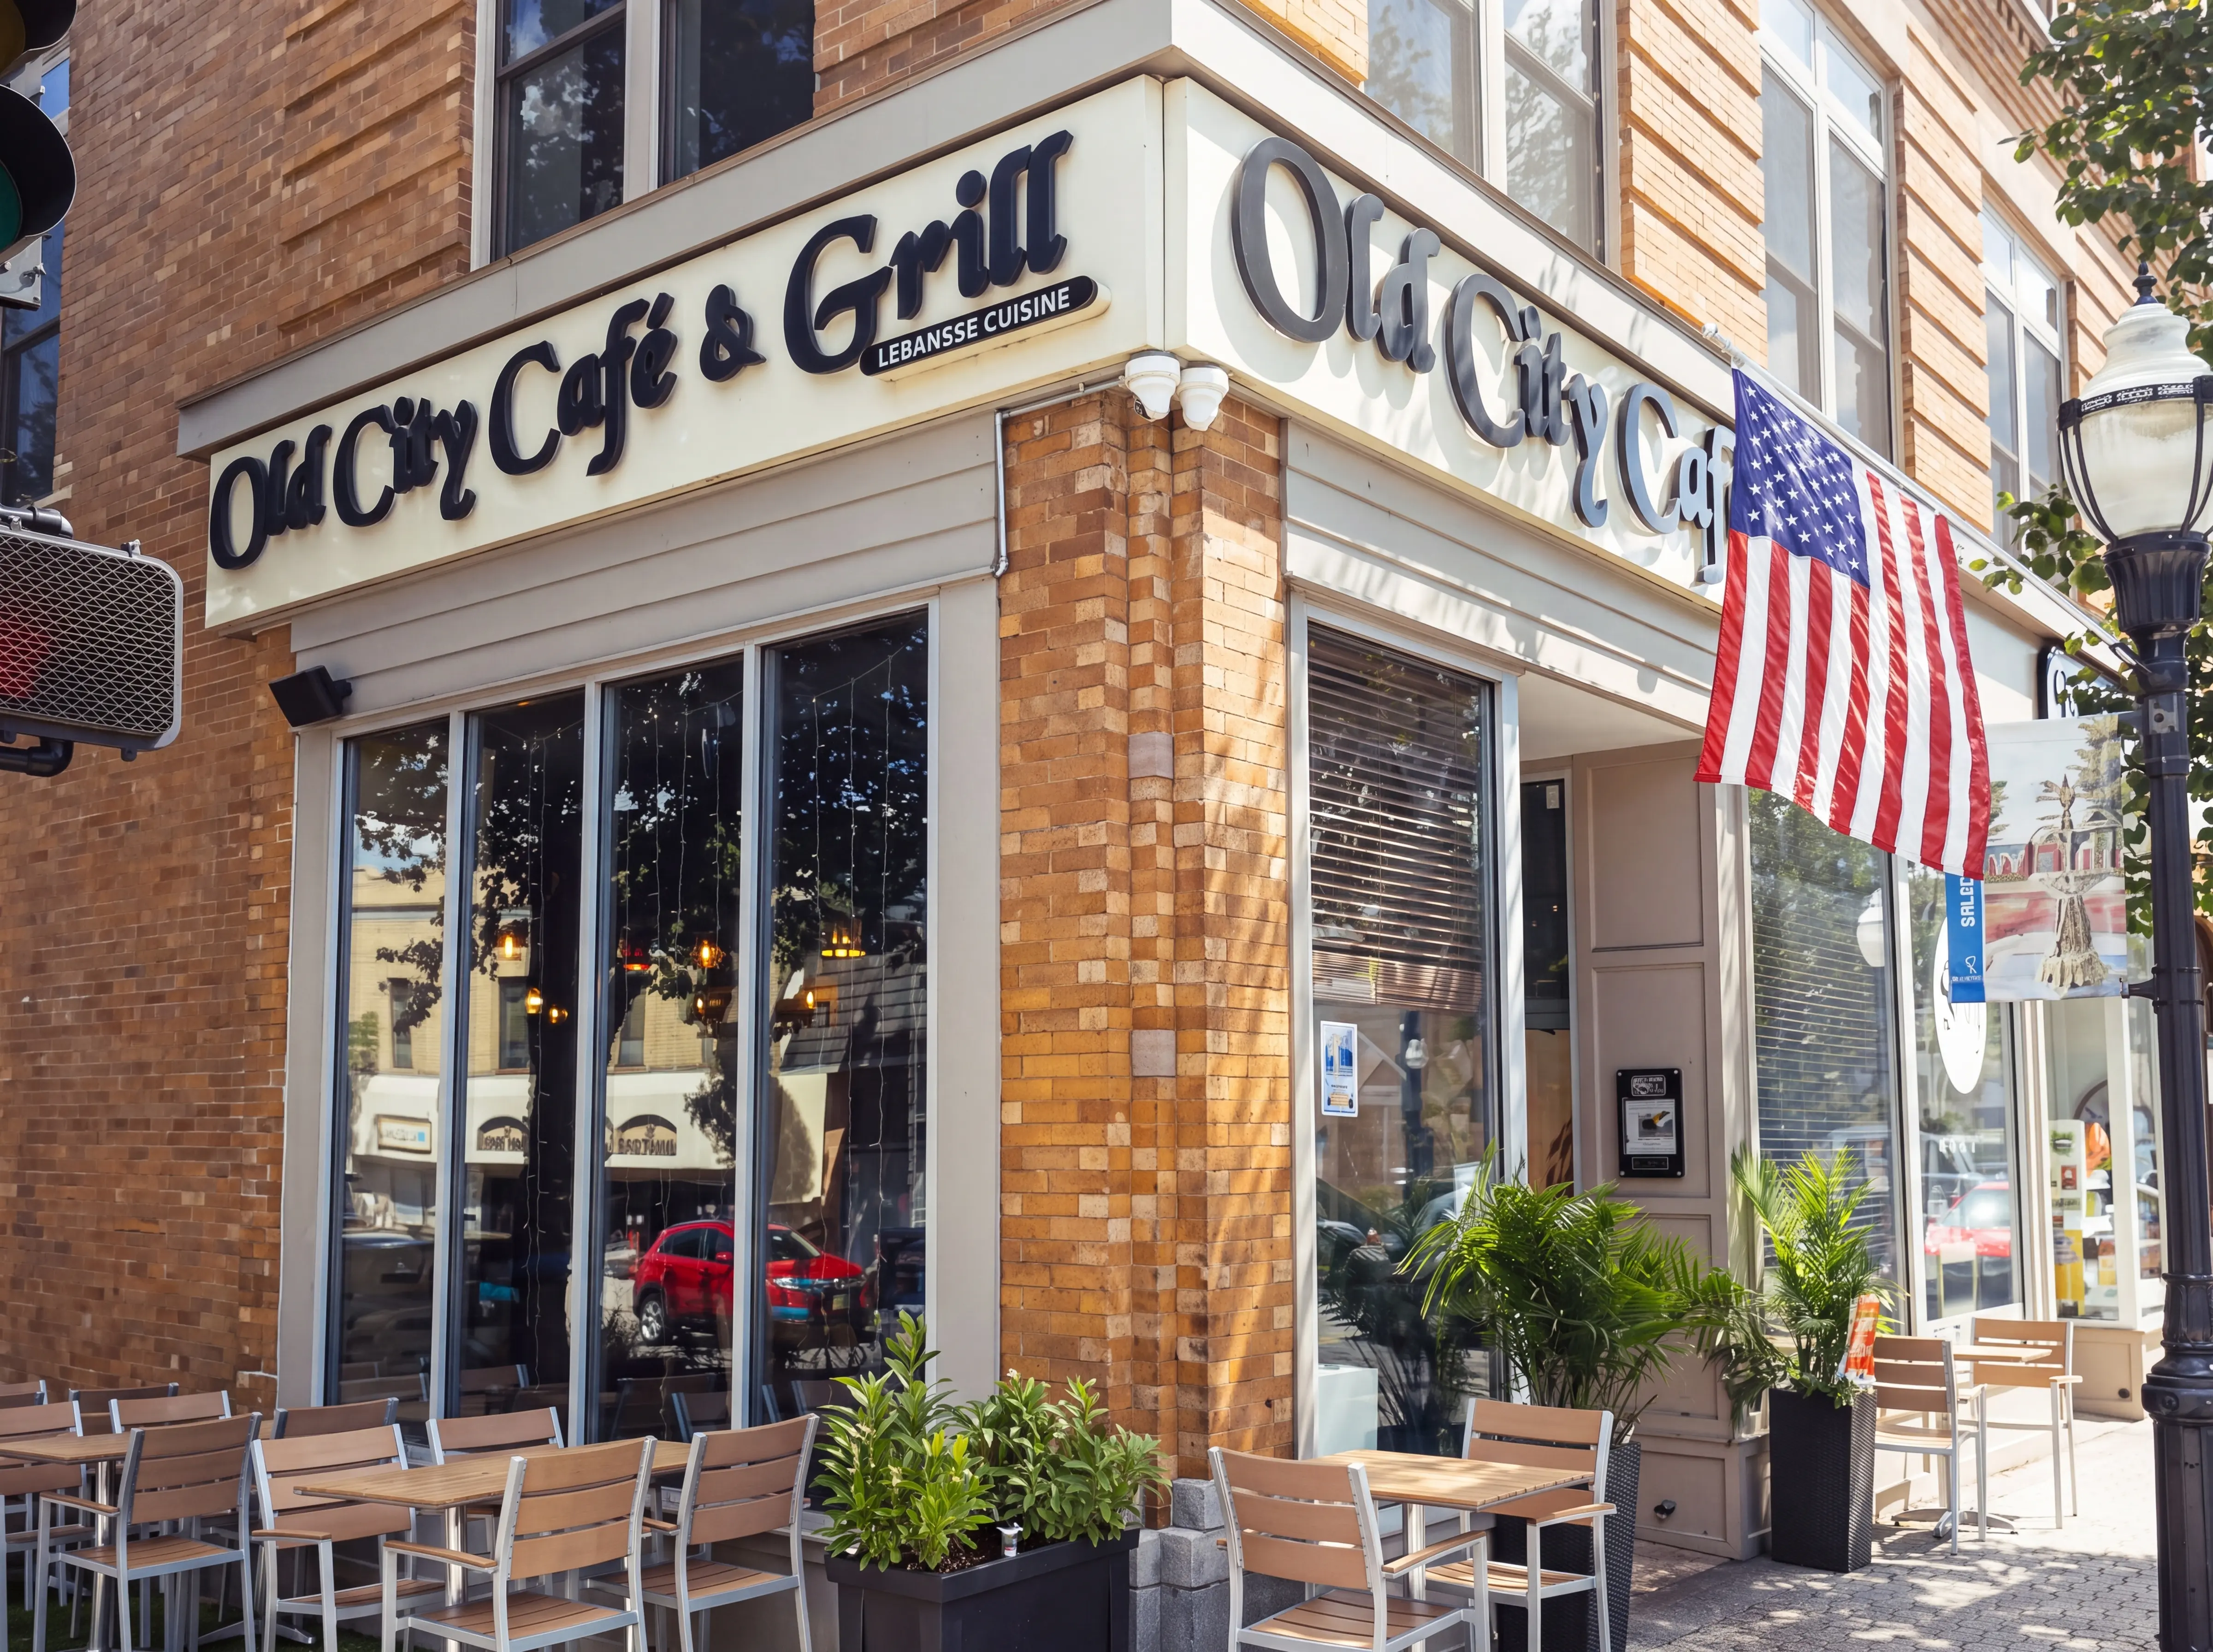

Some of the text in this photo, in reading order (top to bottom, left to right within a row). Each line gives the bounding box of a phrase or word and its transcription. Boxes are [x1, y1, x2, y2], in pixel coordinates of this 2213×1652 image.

[210, 130, 1074, 571] Old City Café & Grill
[879, 286, 1070, 367] LEBANSSE CUISINE
[1231, 136, 1736, 584] Old City Caf
